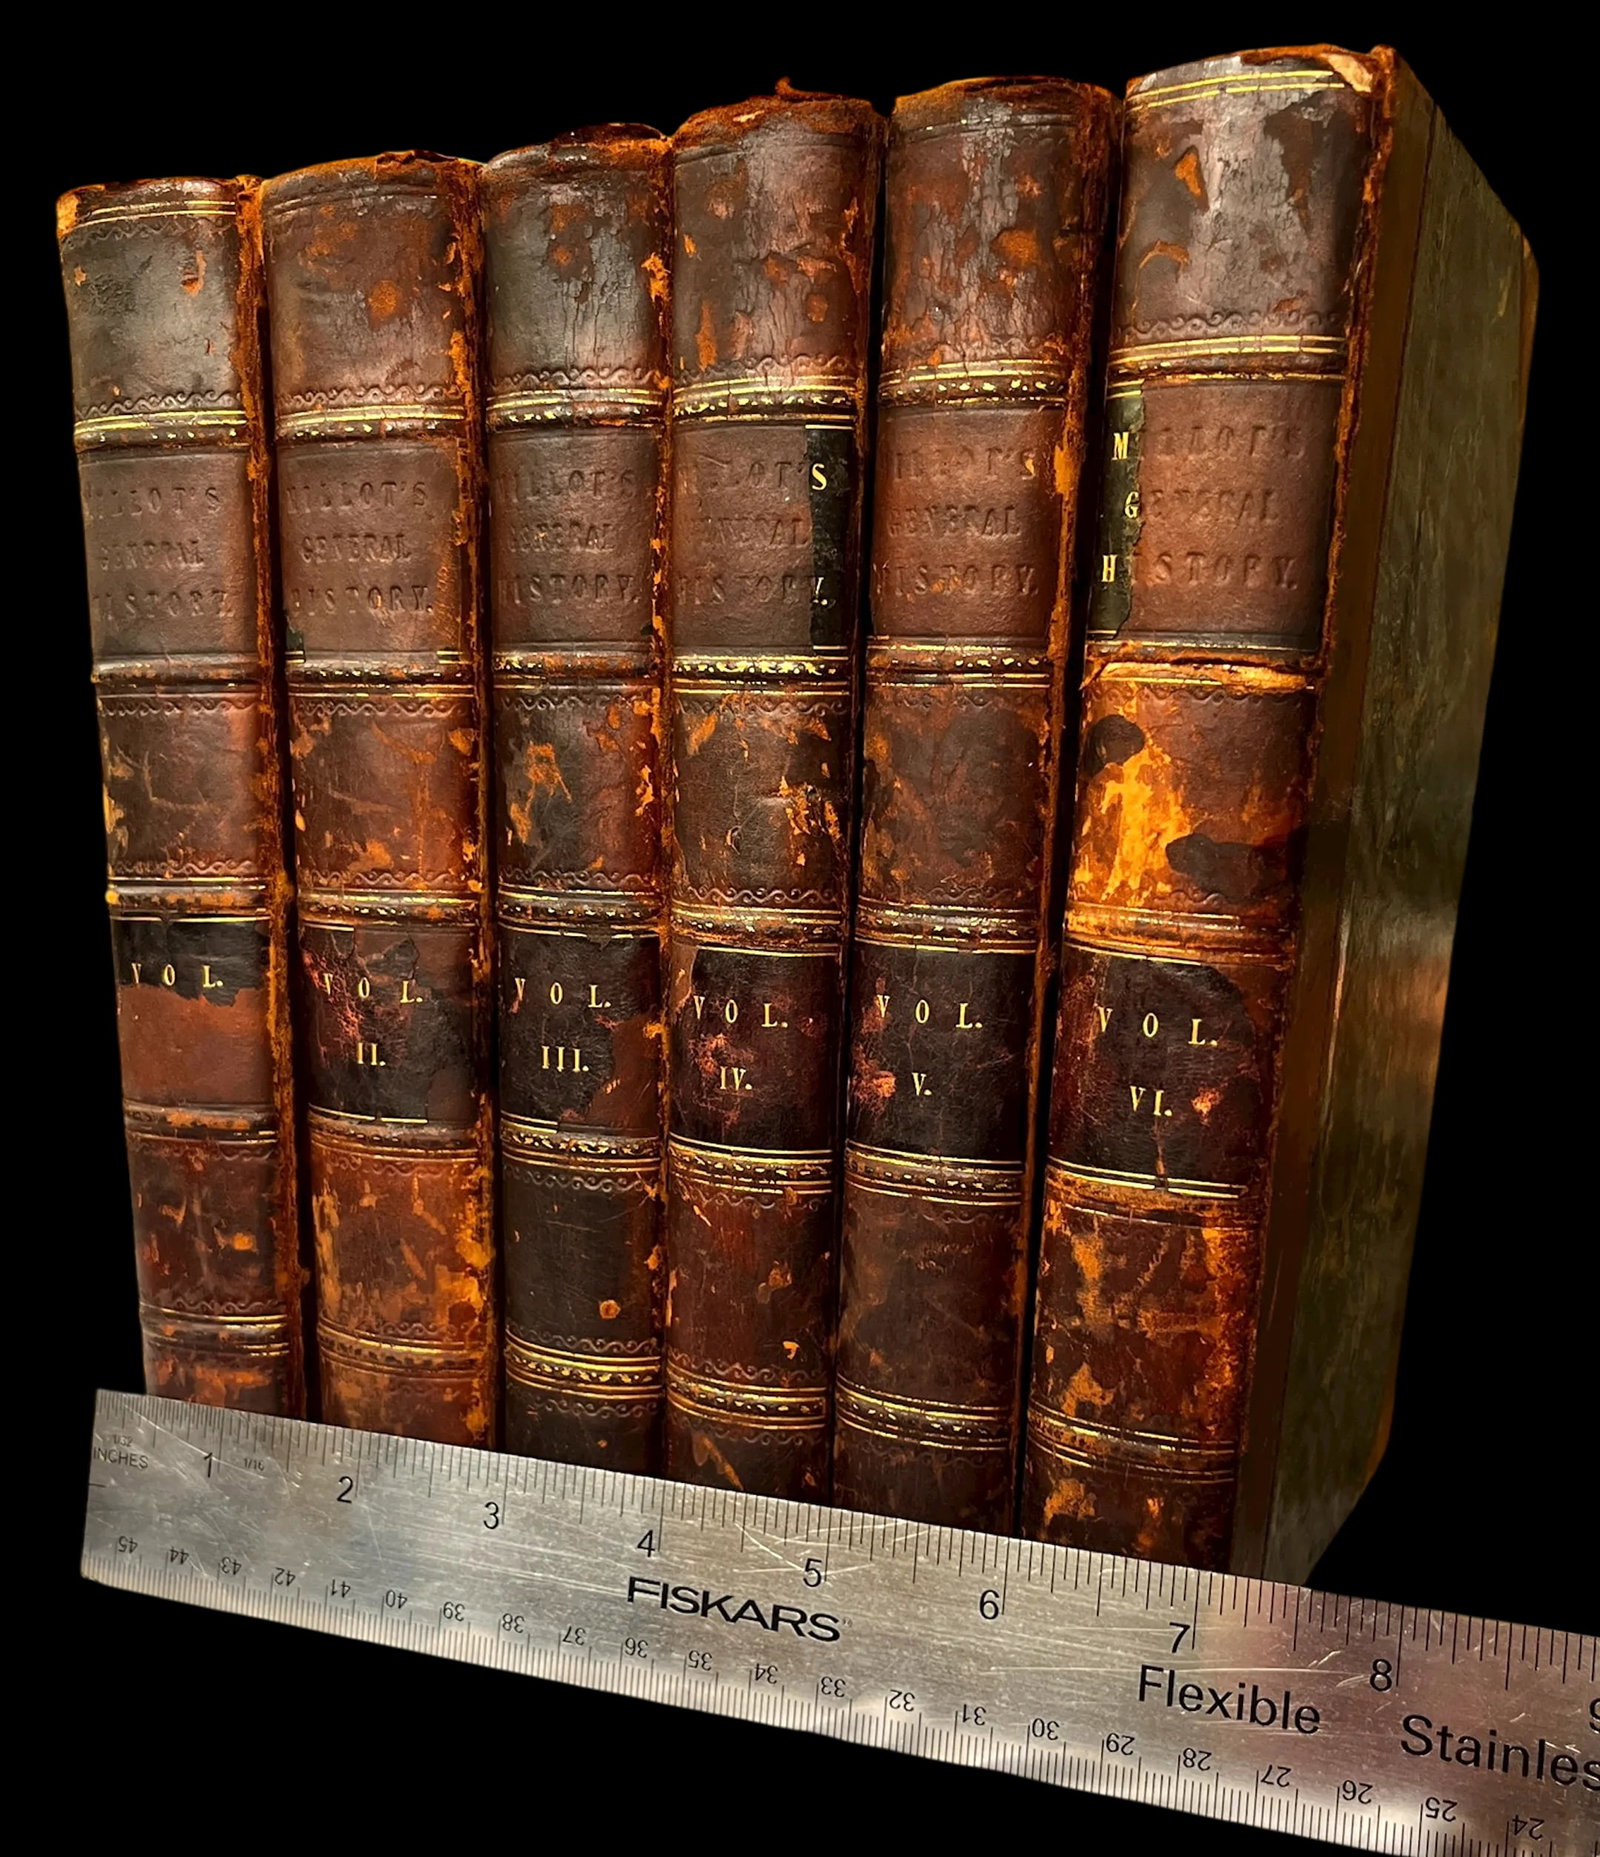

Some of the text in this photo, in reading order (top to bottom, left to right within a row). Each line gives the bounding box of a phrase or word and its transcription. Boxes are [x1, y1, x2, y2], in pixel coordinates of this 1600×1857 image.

[301, 533, 411, 563] GENERAL
[131, 962, 224, 989] VOL.
[323, 973, 423, 1004] VOL.
[514, 977, 612, 1008] VOL.
[693, 995, 788, 1028] VOL.
[875, 994, 983, 1029] VOL.
[1097, 1006, 1218, 1047] VOL.
[357, 1042, 386, 1067] II.
[541, 1045, 590, 1073] III.
[719, 1066, 753, 1091] IV.
[911, 1072, 932, 1096] V.
[1130, 1085, 1173, 1117] VI.
[93, 1448, 149, 1469] INCHES
[203, 1452, 213, 1478] 1
[336, 1475, 354, 1504] 2
[482, 1501, 500, 1530] 3
[637, 1529, 656, 1558] 4
[802, 1557, 823, 1588] 5
[979, 1589, 1000, 1620] 6
[1168, 1621, 1191, 1654] 7
[1369, 1658, 1393, 1692] 8
[626, 1575, 842, 1643] FISKARS
[118, 1536, 1545, 1841] 24 25 26 27 28 29 30 31 32 33 34 35 36 37 38 39 40 41 42 43 44 45
[1138, 1664, 1321, 1736] Flexible
